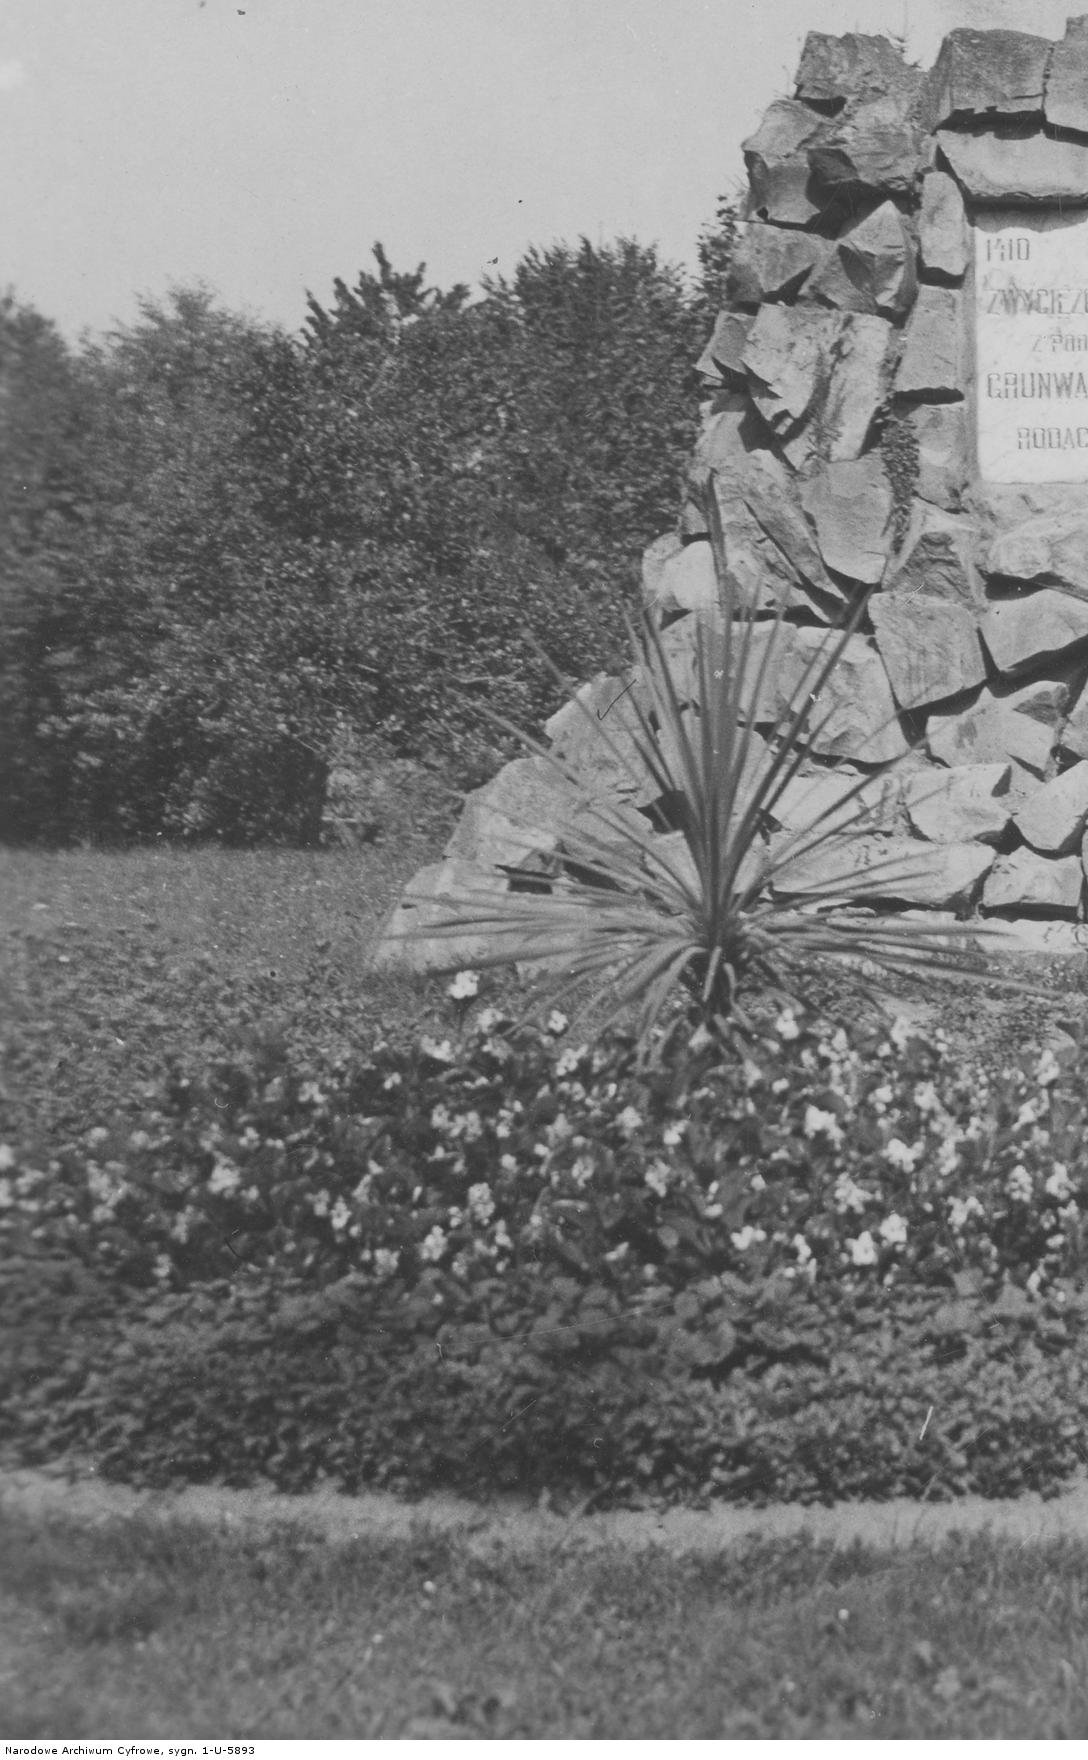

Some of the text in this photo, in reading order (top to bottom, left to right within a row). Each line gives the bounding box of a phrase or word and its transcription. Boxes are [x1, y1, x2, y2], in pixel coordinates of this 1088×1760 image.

[987, 238, 1030, 261] 1410
[1031, 334, 1088, 352] Z POD
